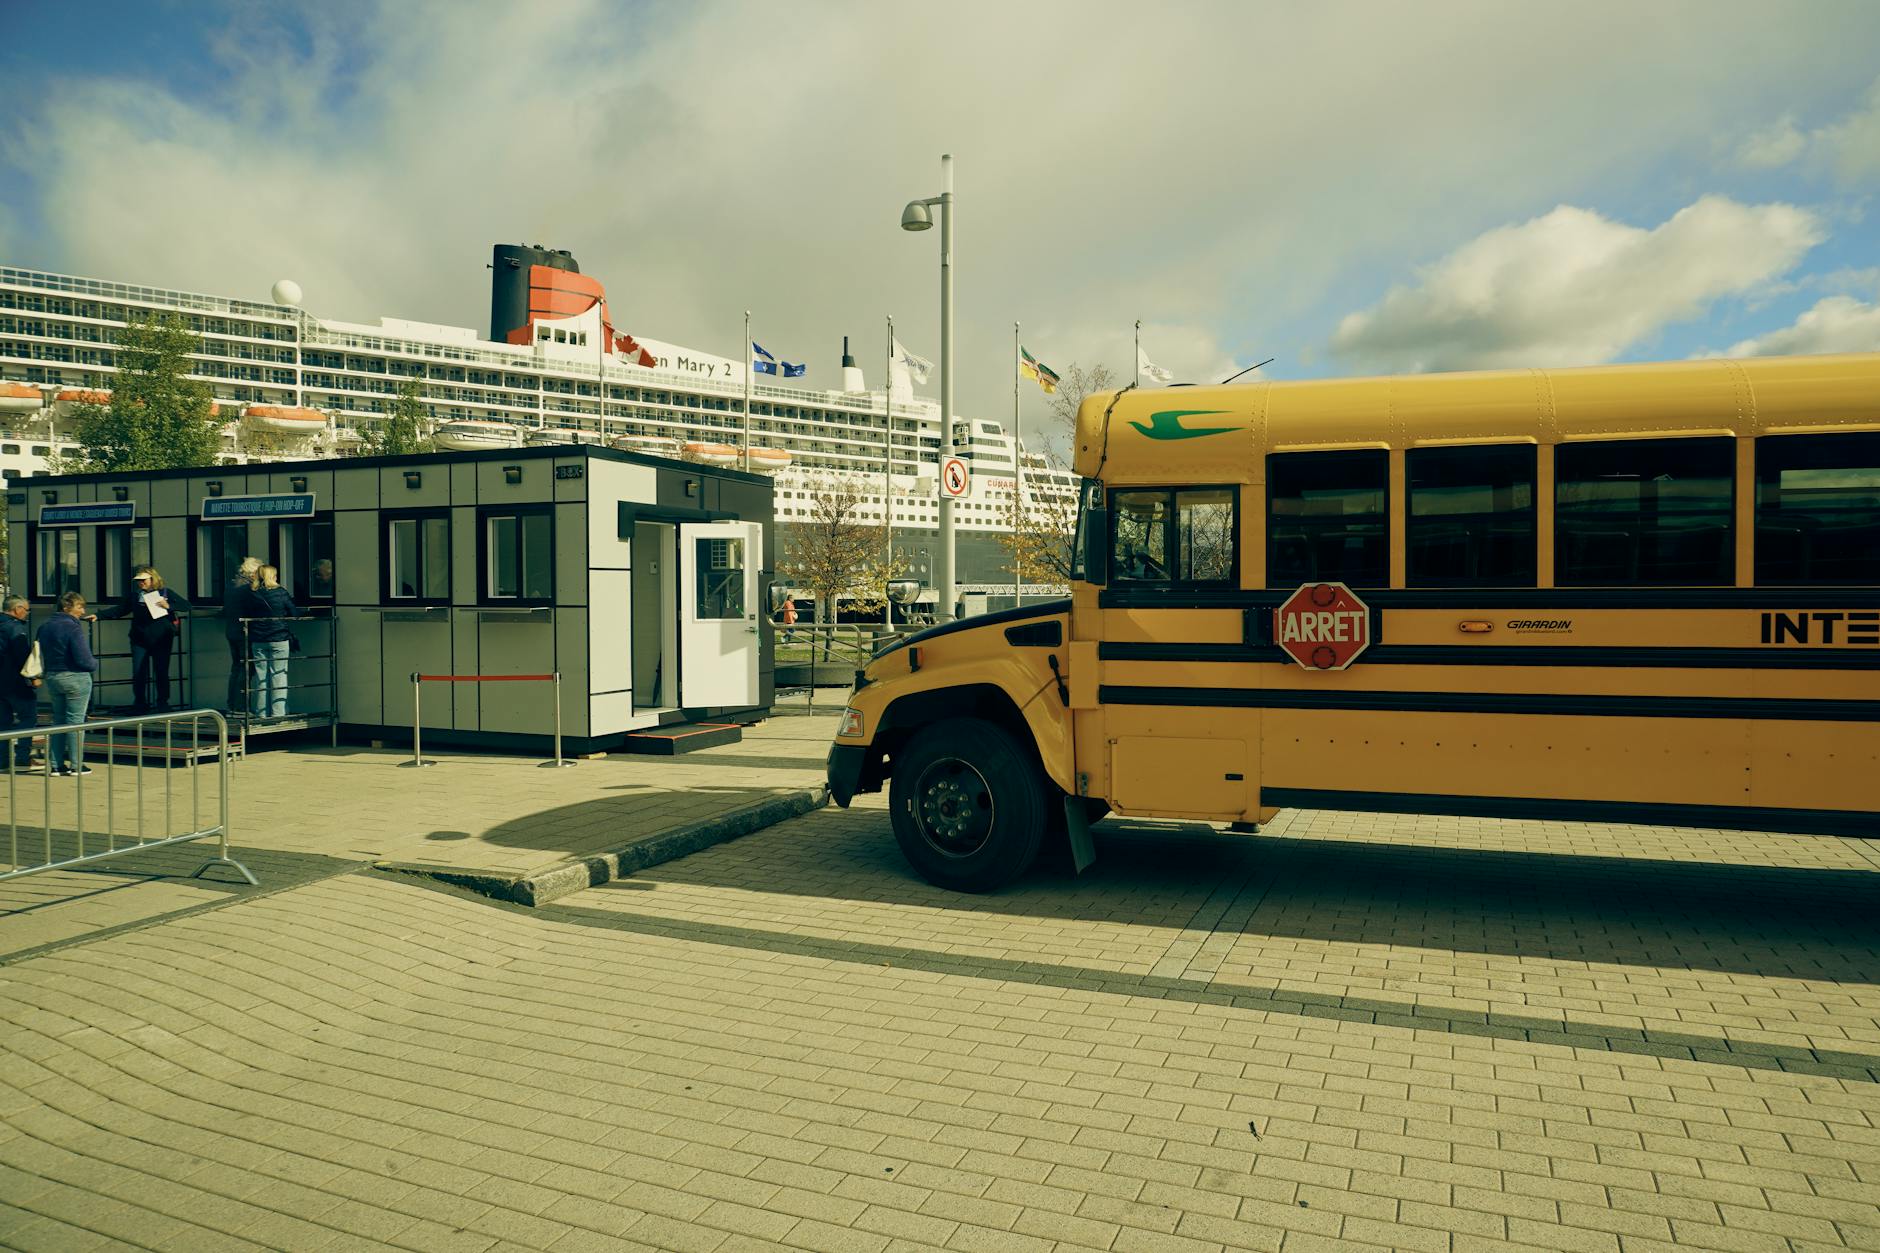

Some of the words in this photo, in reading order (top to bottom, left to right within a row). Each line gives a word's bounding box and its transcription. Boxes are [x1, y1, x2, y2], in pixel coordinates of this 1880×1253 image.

[678, 357, 715, 377] Mary
[724, 363, 732, 376] 2
[987, 480, 1018, 489] CUNAR
[1283, 601, 1364, 642] ARRÊT
[1507, 620, 1572, 629] GIRARDIN
[1761, 613, 1880, 644] INTE
